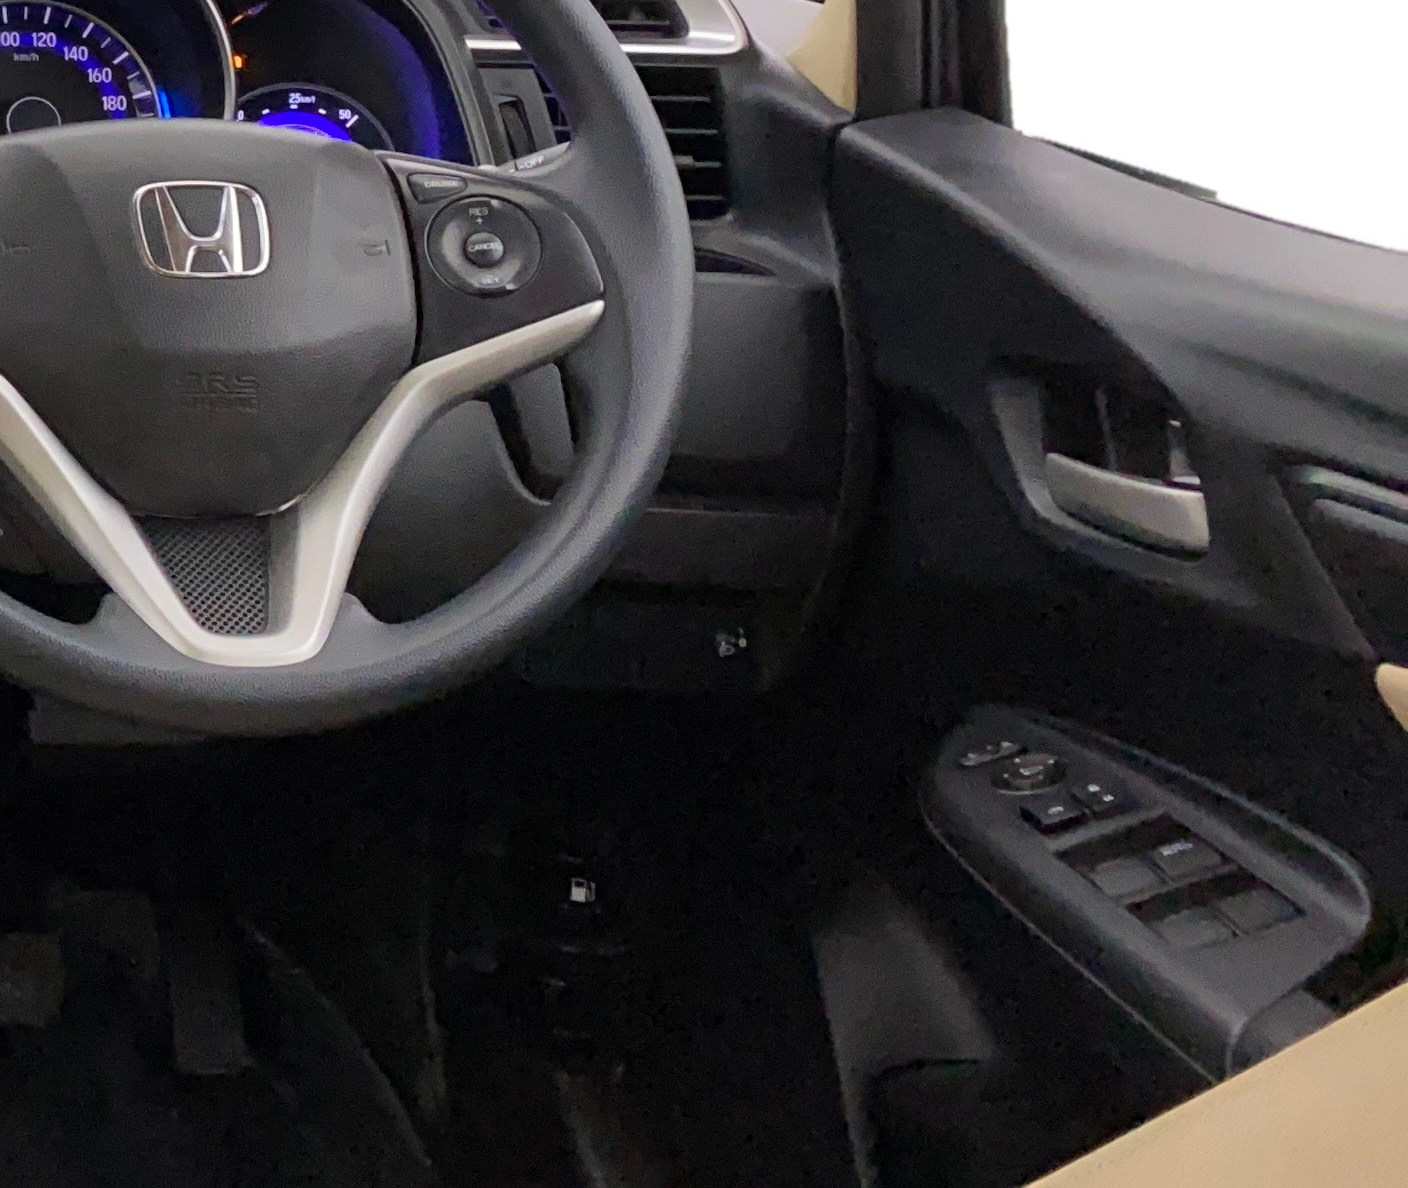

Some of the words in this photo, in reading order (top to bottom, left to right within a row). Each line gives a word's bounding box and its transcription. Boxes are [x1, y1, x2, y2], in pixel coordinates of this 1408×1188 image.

[32, 31, 56, 47] 120
[13, 52, 39, 62] km/h
[63, 46, 88, 61] 140
[87, 68, 112, 83] 160
[102, 95, 127, 111] 180
[338, 108, 352, 120] 50
[468, 241, 502, 252] CANCEL
